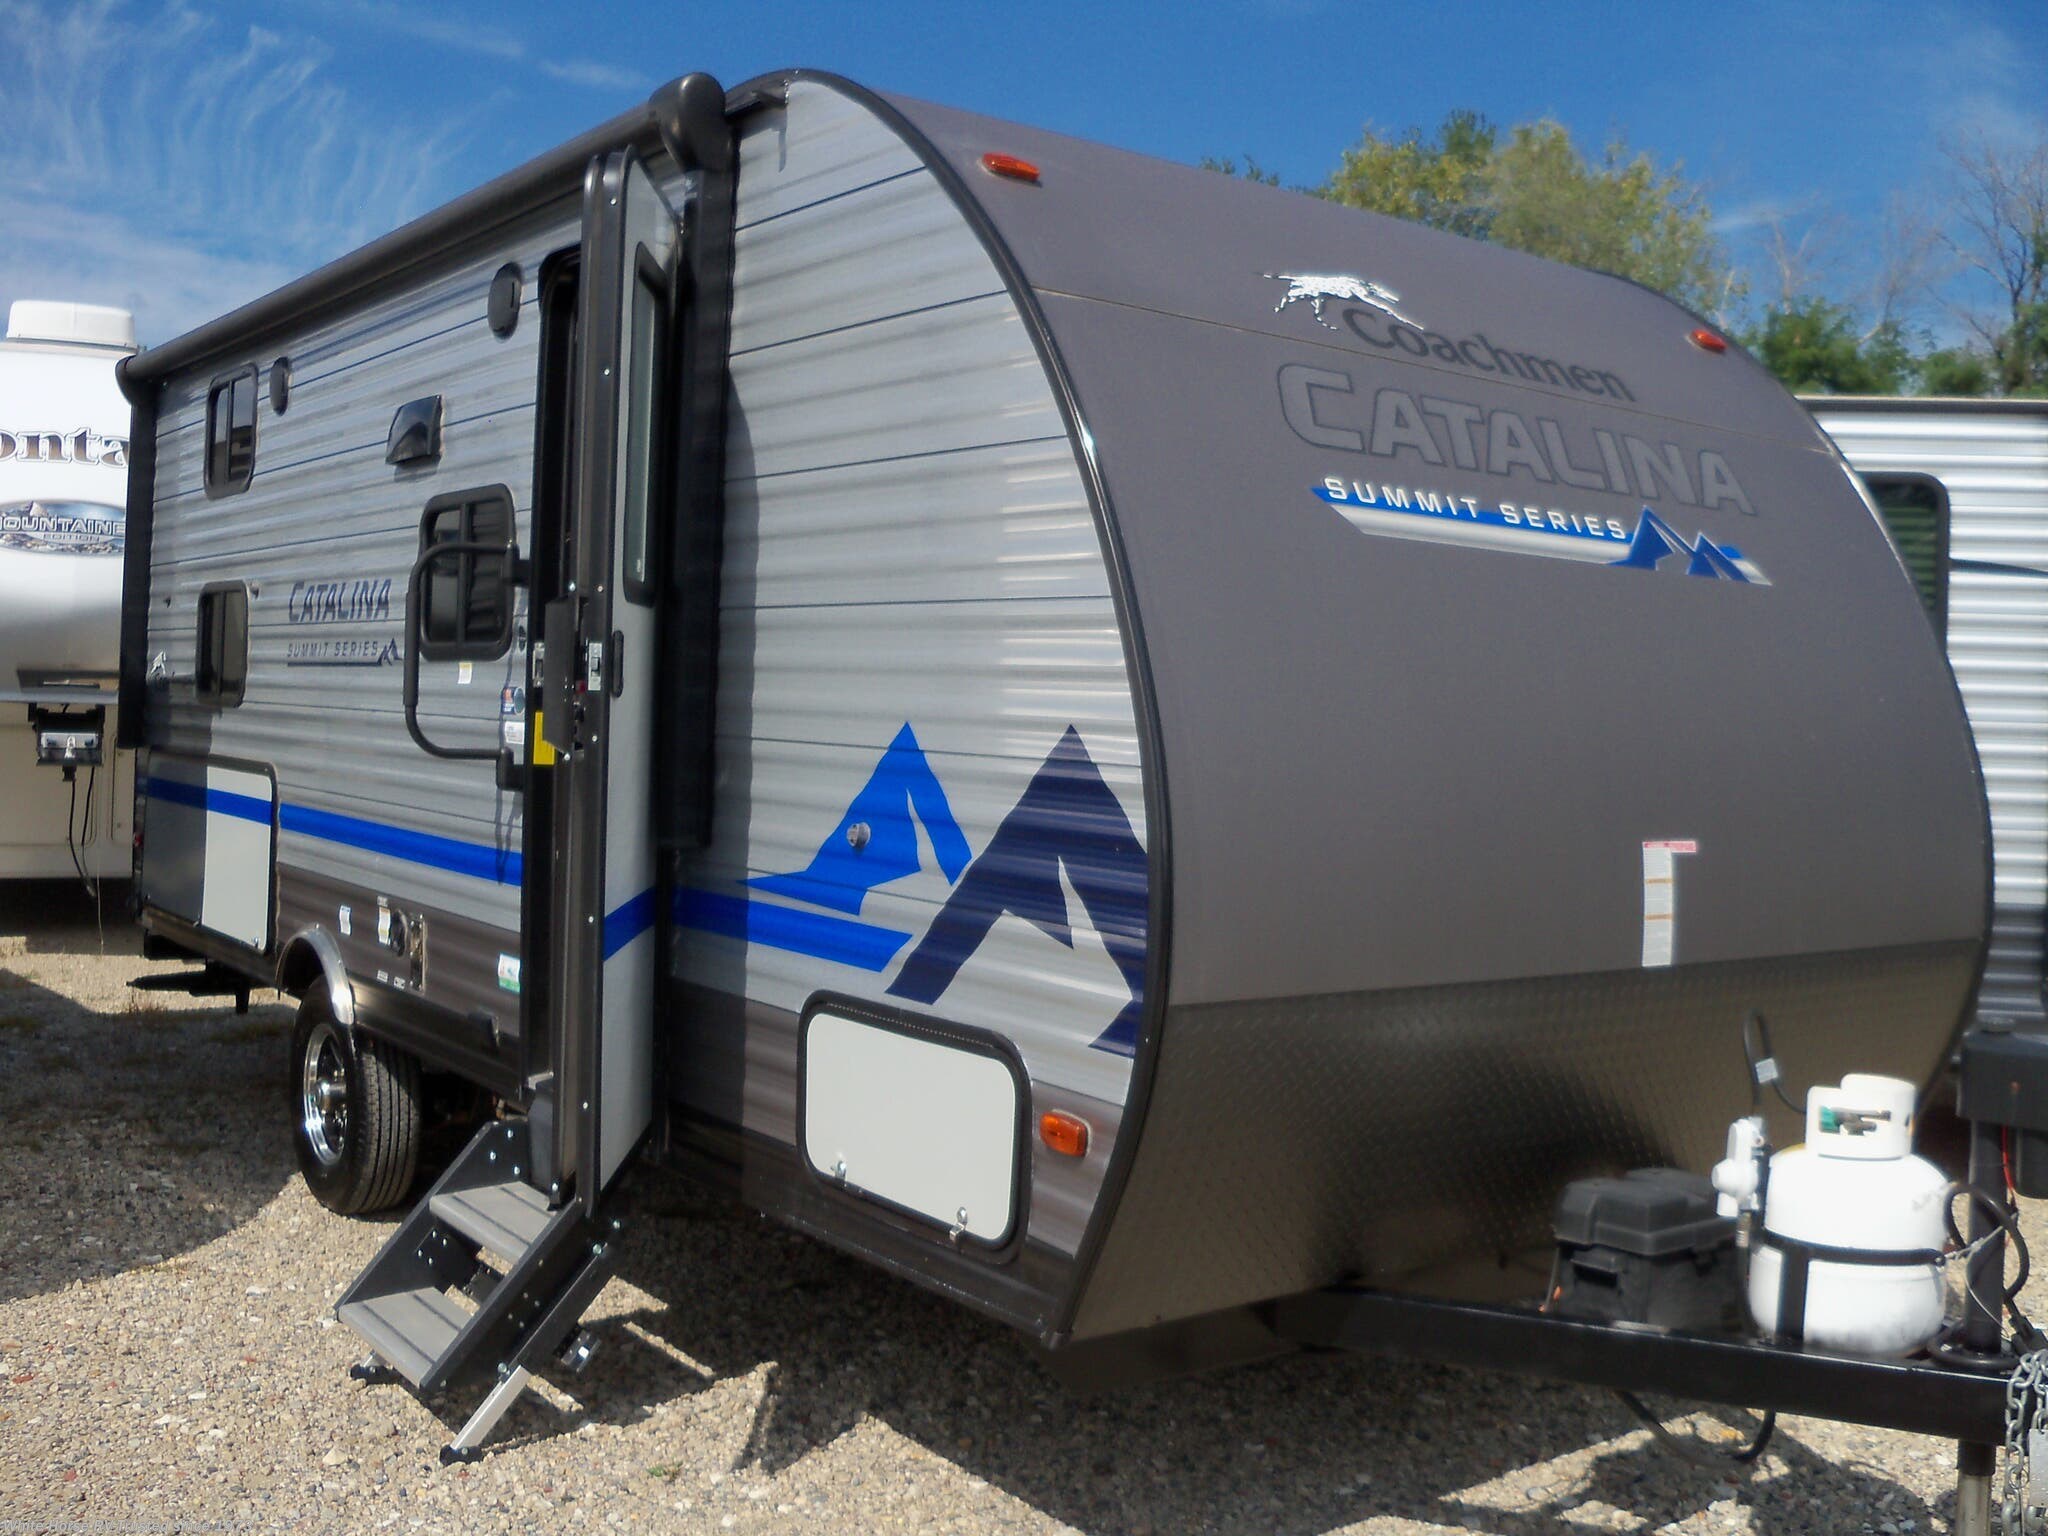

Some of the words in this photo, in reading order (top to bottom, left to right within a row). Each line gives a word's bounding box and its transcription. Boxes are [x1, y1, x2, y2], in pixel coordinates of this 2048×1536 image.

[1342, 308, 1636, 402] Coachmen
[1277, 363, 1757, 516] CATALINA
[0, 515, 125, 536] OUNTAINE
[1323, 477, 1478, 519] SUMMIT
[1501, 504, 1627, 540] SERIES
[289, 579, 392, 622] CATALINA
[287, 642, 329, 658] SUMMIT
[334, 641, 378, 657] SERIES
